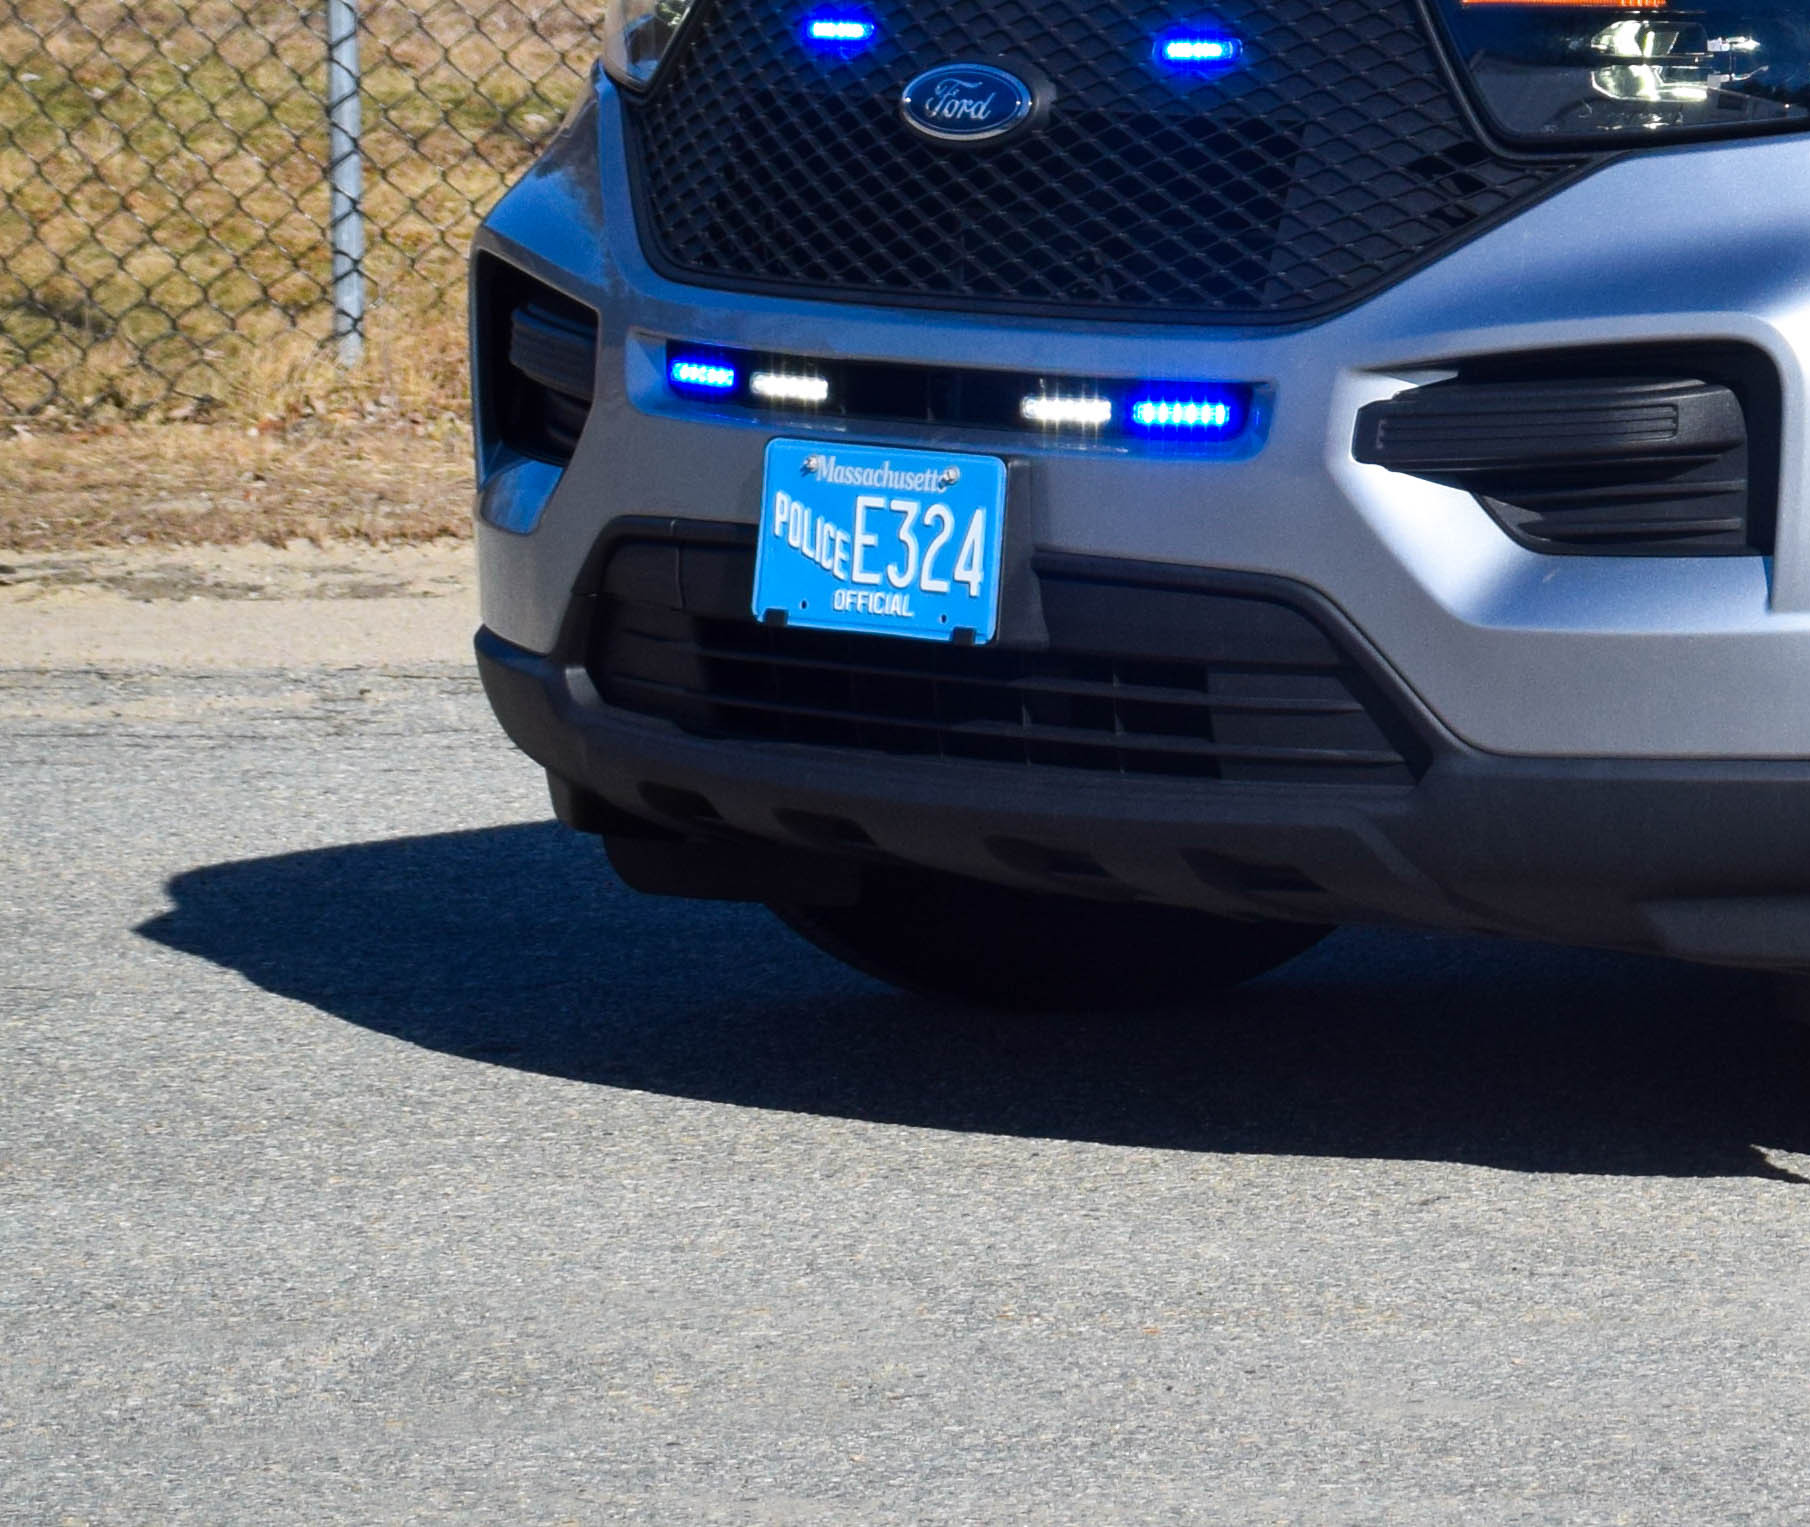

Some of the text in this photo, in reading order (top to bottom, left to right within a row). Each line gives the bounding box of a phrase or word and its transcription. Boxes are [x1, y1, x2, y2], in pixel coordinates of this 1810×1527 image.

[924, 78, 994, 122] Ford
[773, 490, 987, 598] POLICE E324
[831, 588, 915, 618] OFFICIAL
